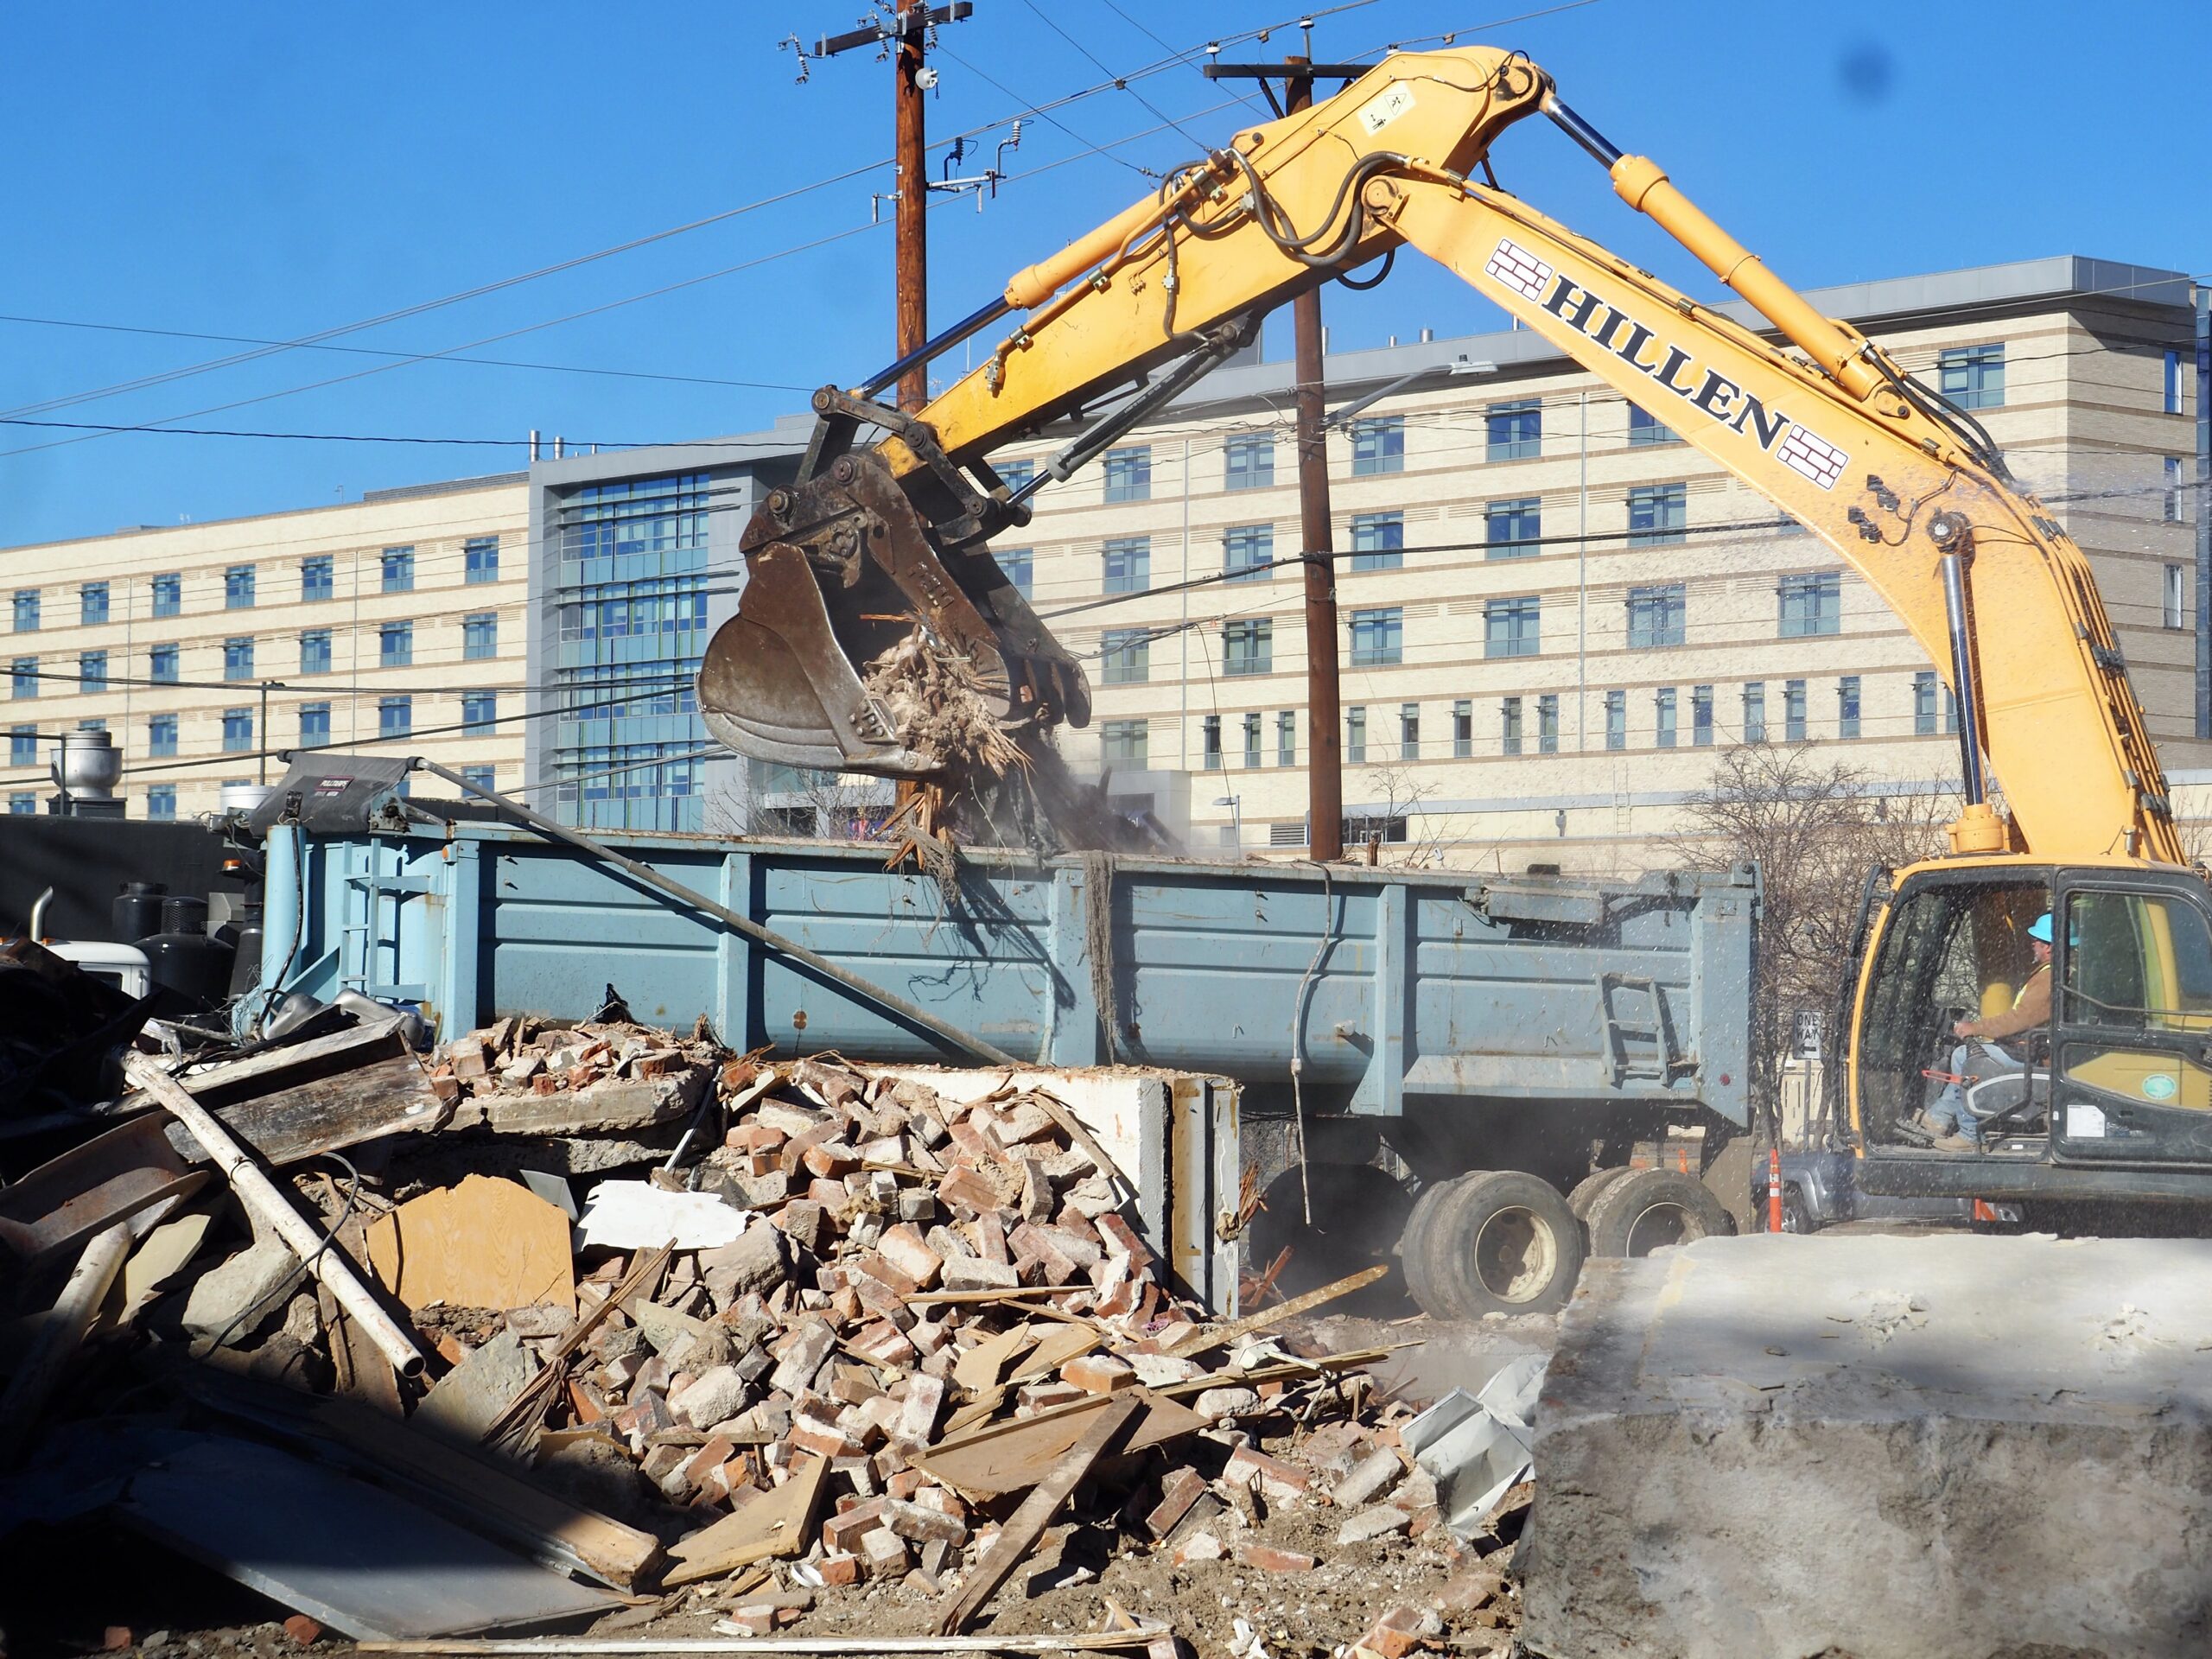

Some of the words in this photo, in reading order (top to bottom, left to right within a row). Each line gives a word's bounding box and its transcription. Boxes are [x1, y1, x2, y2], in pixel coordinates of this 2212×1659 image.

[1541, 273, 1789, 451] HILLEN
[1797, 1014, 1818, 1026] ONE
[1797, 1028, 1818, 1039] WAY
